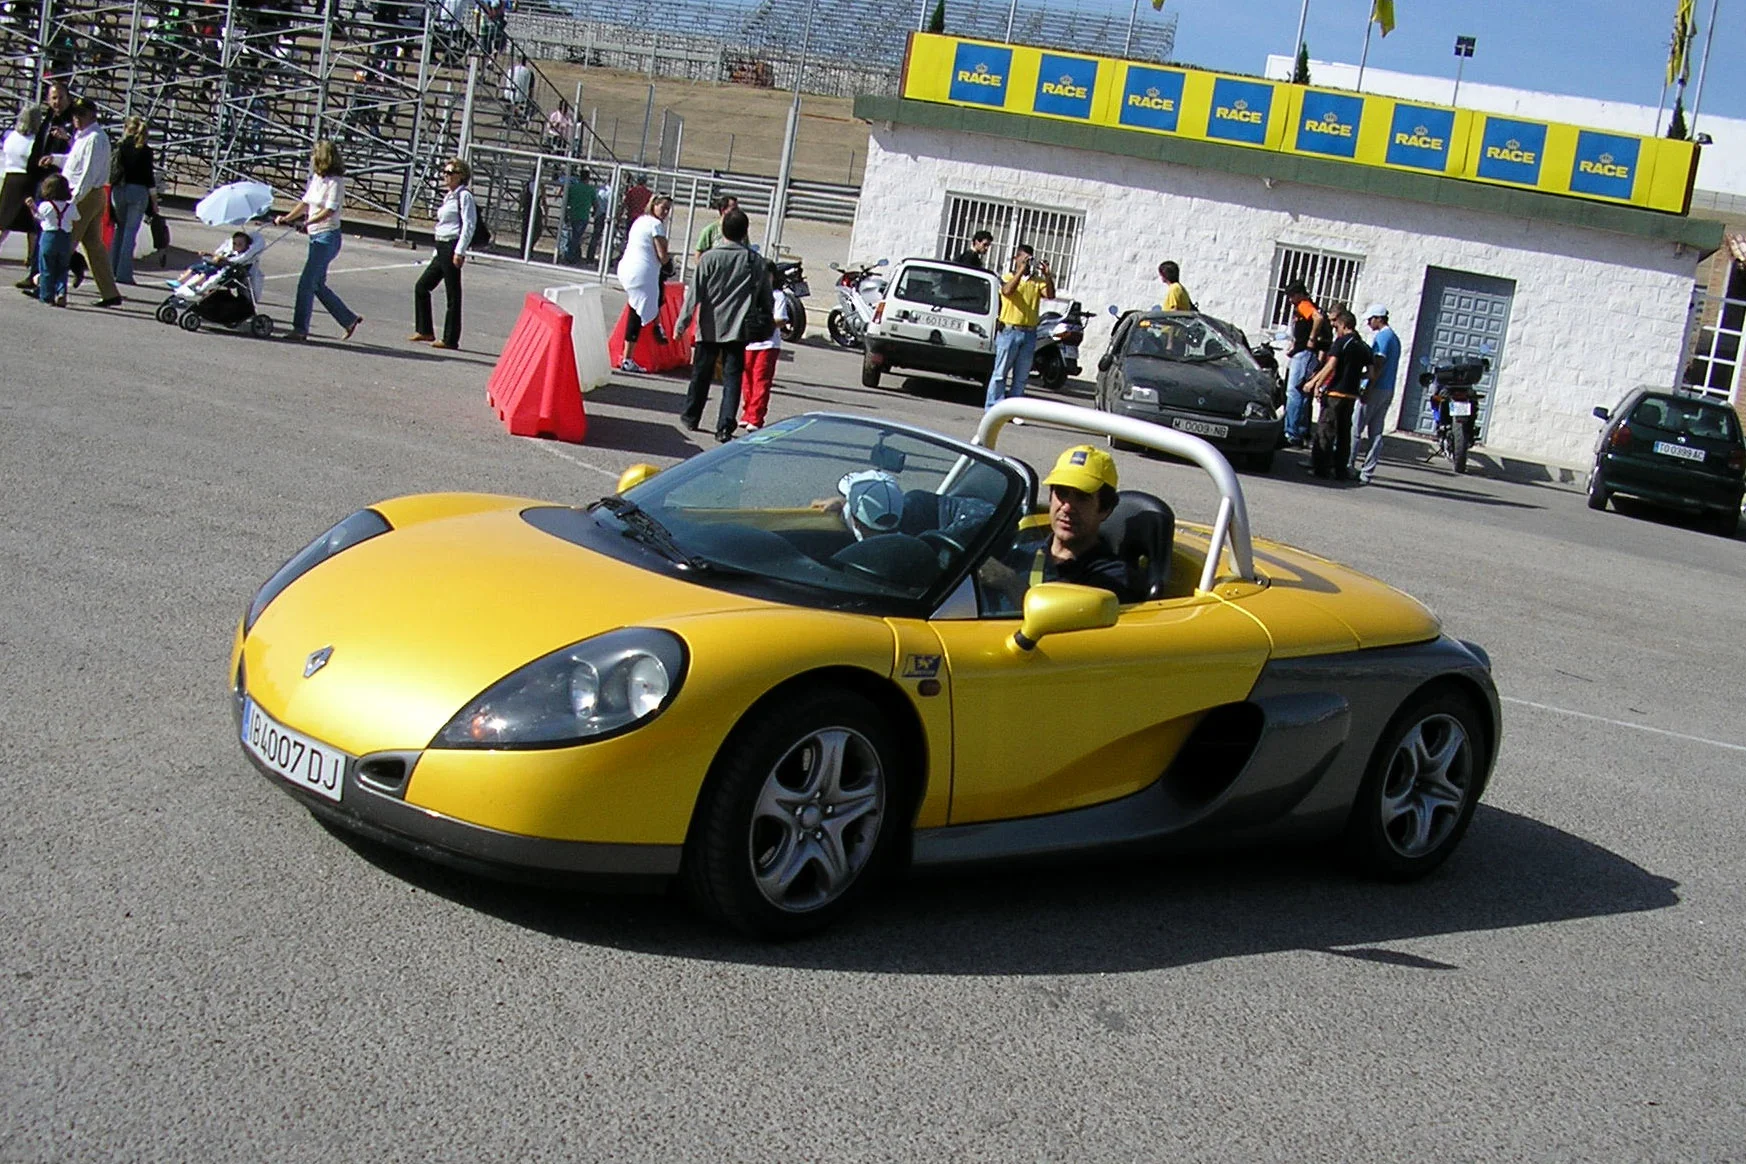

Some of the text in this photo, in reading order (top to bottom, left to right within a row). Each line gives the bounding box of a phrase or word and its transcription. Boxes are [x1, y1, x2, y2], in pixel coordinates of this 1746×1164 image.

[958, 70, 1001, 86] RACE
[1042, 82, 1086, 99] RACE
[1128, 95, 1173, 111] RACE
[1216, 107, 1261, 123] RACE
[1305, 120, 1351, 137] RACE
[1395, 133, 1441, 150] RACE
[1487, 147, 1534, 164] RACE
[1580, 161, 1627, 178] RACE
